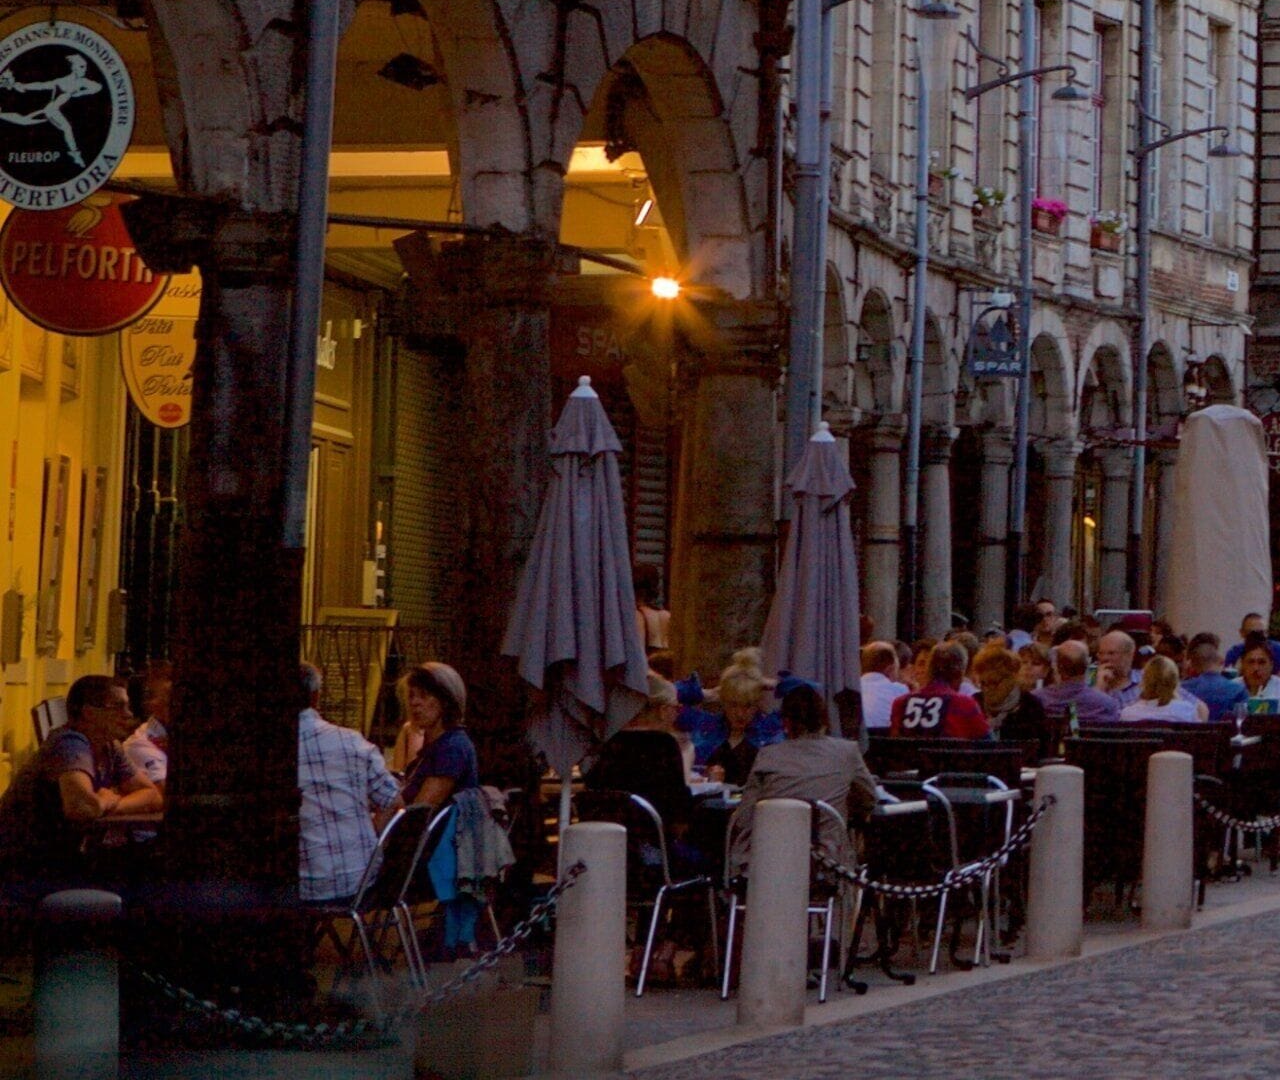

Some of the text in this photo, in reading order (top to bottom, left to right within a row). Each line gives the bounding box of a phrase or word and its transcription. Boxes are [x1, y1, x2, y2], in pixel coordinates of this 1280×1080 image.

[14, 27, 50, 48] DANS
[54, 27, 70, 39] LE
[74, 30, 114, 67] MONDE
[112, 69, 129, 126] ENTIER
[8, 151, 61, 163] FLEUROP
[974, 361, 1021, 372] SPAR
[902, 696, 944, 729] 53
